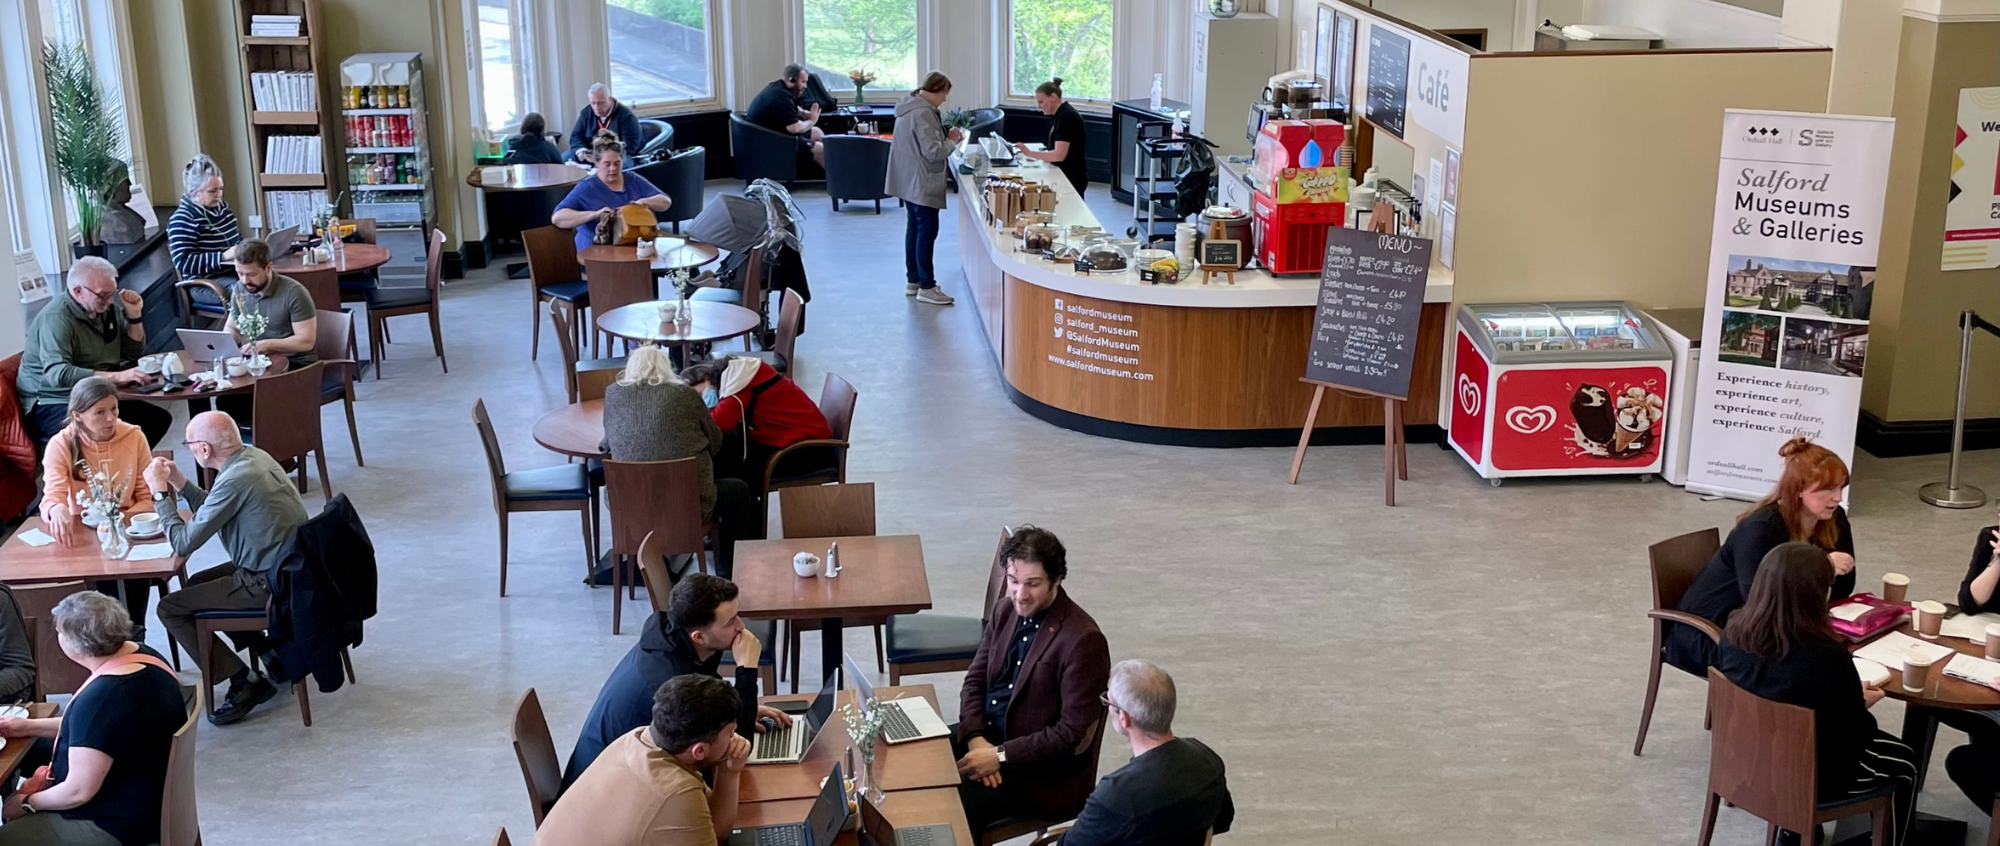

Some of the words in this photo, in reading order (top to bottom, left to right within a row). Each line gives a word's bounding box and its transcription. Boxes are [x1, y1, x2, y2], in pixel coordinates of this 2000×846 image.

[1418, 61, 1449, 113] Café
[1737, 168, 1830, 194] Salford
[1735, 191, 1850, 219] Museums
[1732, 217, 1753, 235] &
[1760, 218, 1864, 245] Galleries
[1378, 234, 1412, 253] MENU
[1066, 305, 1133, 322] salfordmuseum
[1066, 318, 1138, 337] salford_museum
[1066, 331, 1140, 351] @SalfordMuseum
[1066, 344, 1139, 365] #salfordmuseum
[1048, 354, 1154, 381] www.salfordmuseum.com
[1717, 372, 1782, 389] Experience
[1784, 381, 1830, 396] history,
[1715, 388, 1778, 403] experience
[1781, 397, 1803, 407] art,
[1714, 404, 1777, 418] experience
[1779, 411, 1825, 425] culture,
[1712, 418, 1775, 433] experience
[1777, 425, 1824, 439] Salford.
